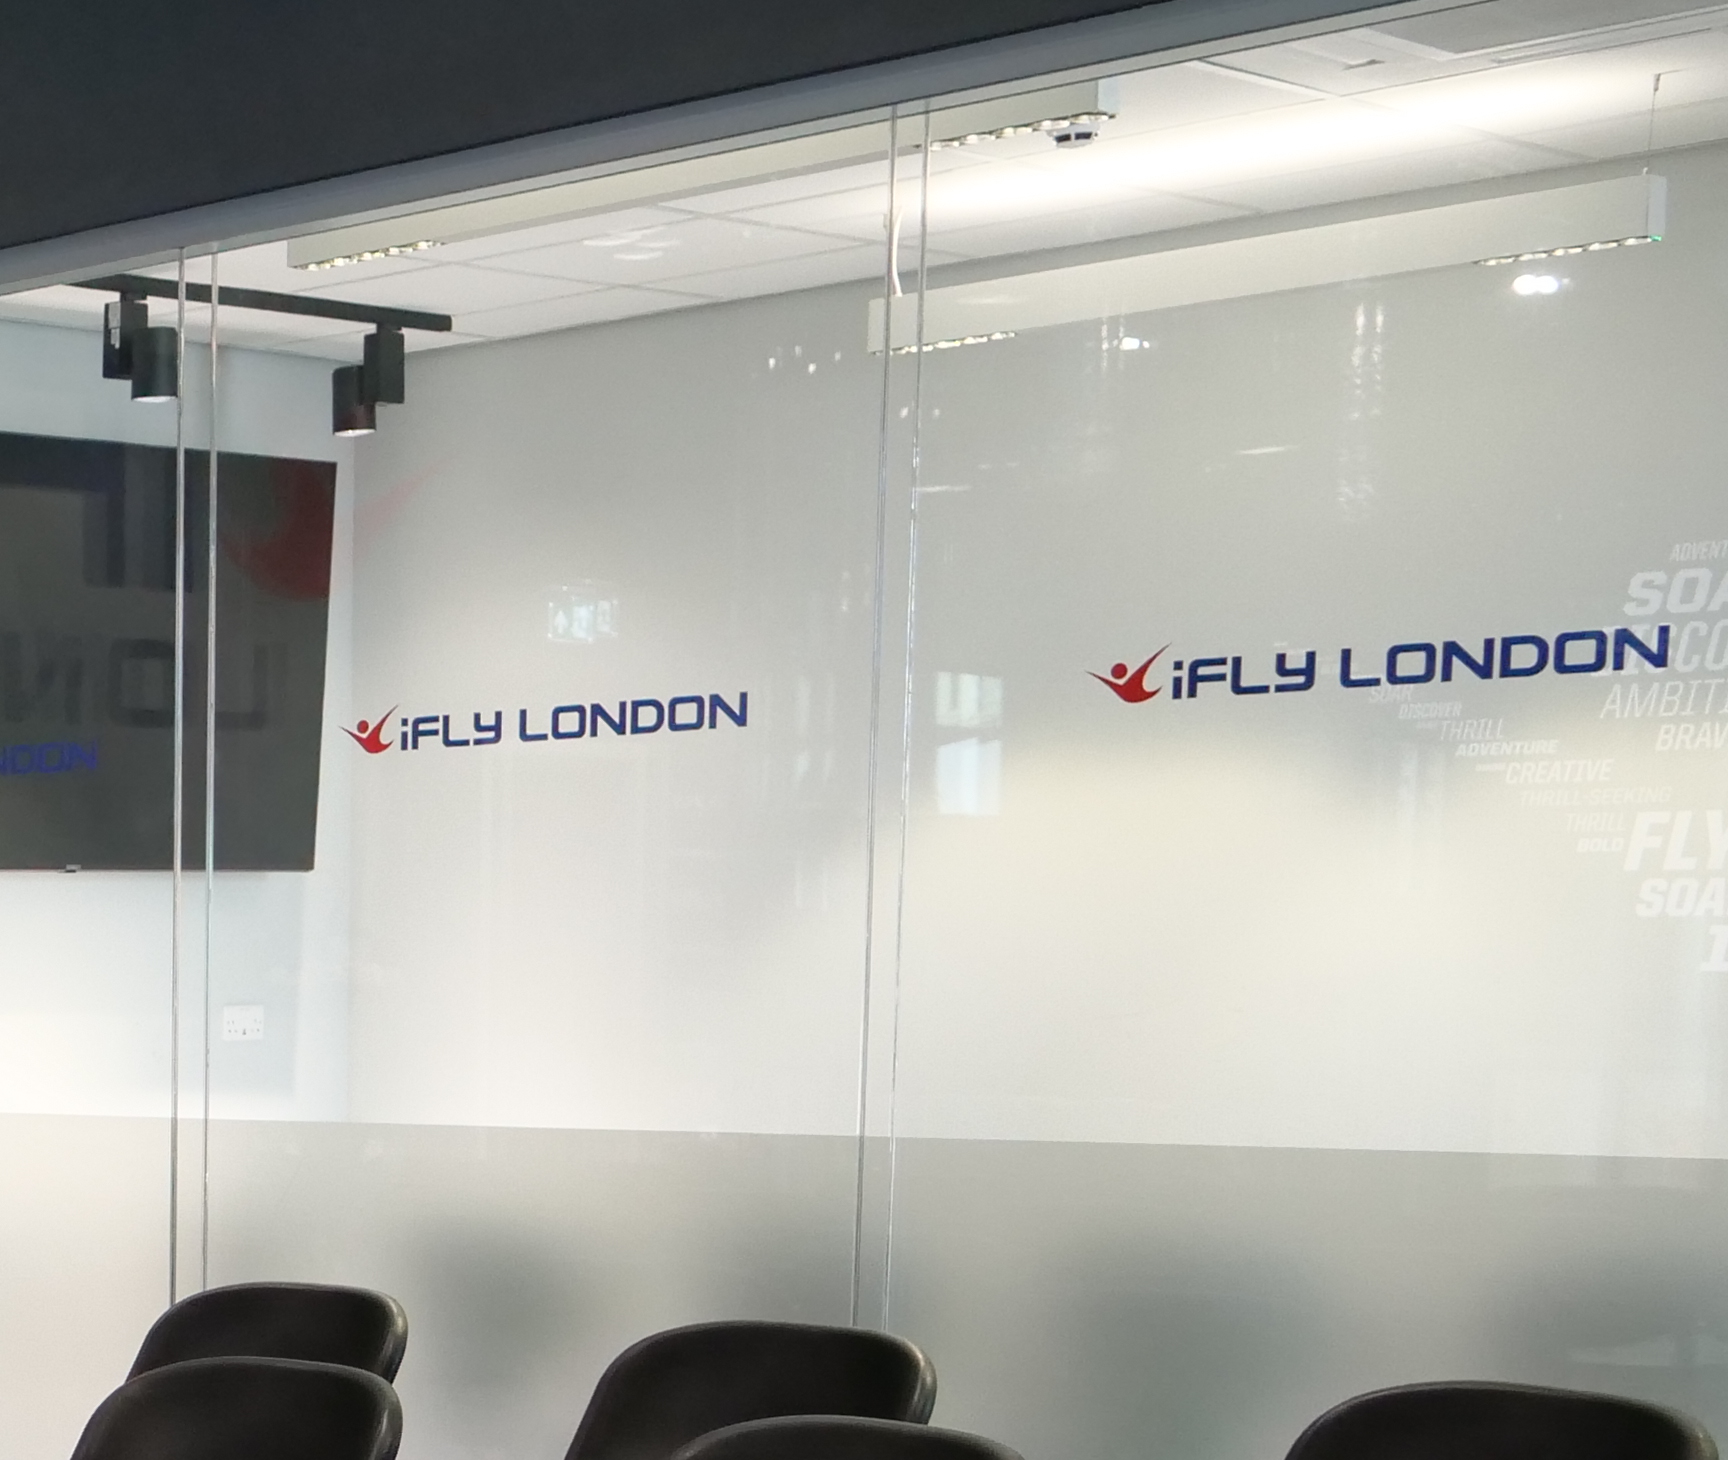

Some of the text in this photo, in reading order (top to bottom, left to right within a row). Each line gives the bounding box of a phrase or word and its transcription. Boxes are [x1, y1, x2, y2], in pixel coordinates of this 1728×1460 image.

[1340, 624, 1670, 688] LONDON
[519, 691, 748, 742] LONDON
[1440, 718, 1504, 741] THRILL
[1455, 739, 1559, 757] ADVENTURE
[1505, 758, 1614, 784] CREATIVE
[1565, 812, 1626, 833] THRILL
[1577, 837, 1624, 853] BOLD
